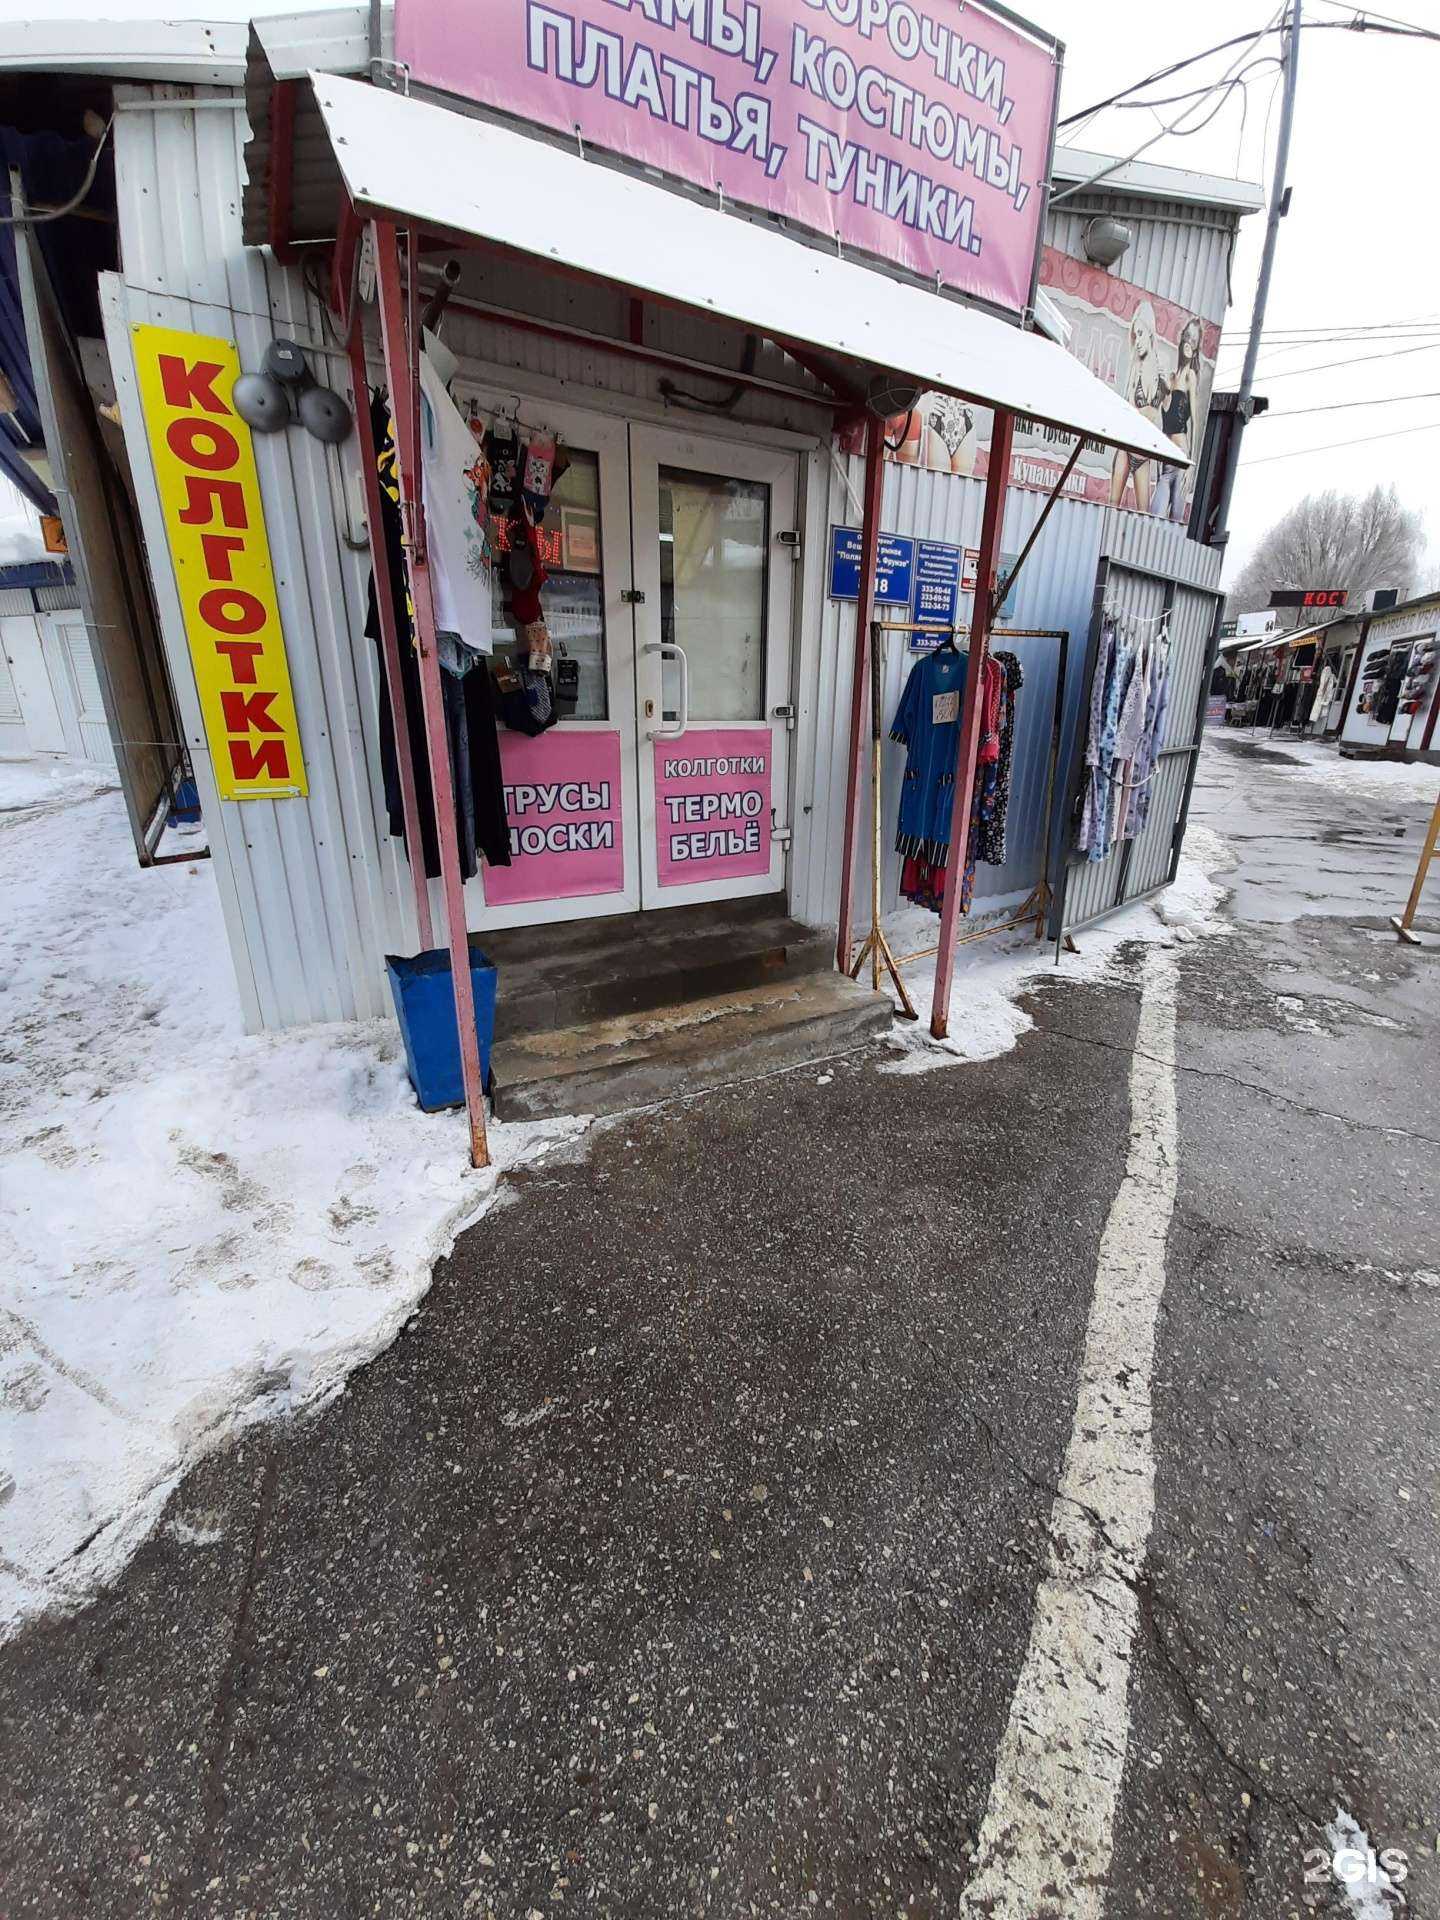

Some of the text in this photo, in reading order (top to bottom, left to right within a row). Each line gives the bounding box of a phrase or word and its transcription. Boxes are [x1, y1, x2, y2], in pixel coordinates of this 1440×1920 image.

[527, 2, 788, 179] ПЛАТЬЯ,
[790, 22, 1030, 212] КОСТЮМЫ,
[800, 0, 1015, 125] РОЧКИ,
[797, 113, 982, 256] ТУНИКИ.
[157, 353, 292, 781] КОЛГОТКИ
[664, 756, 765, 778] КОЛГОТКИ
[664, 790, 763, 824] ТЕРМО
[670, 820, 760, 862] БЕЛЬЁ
